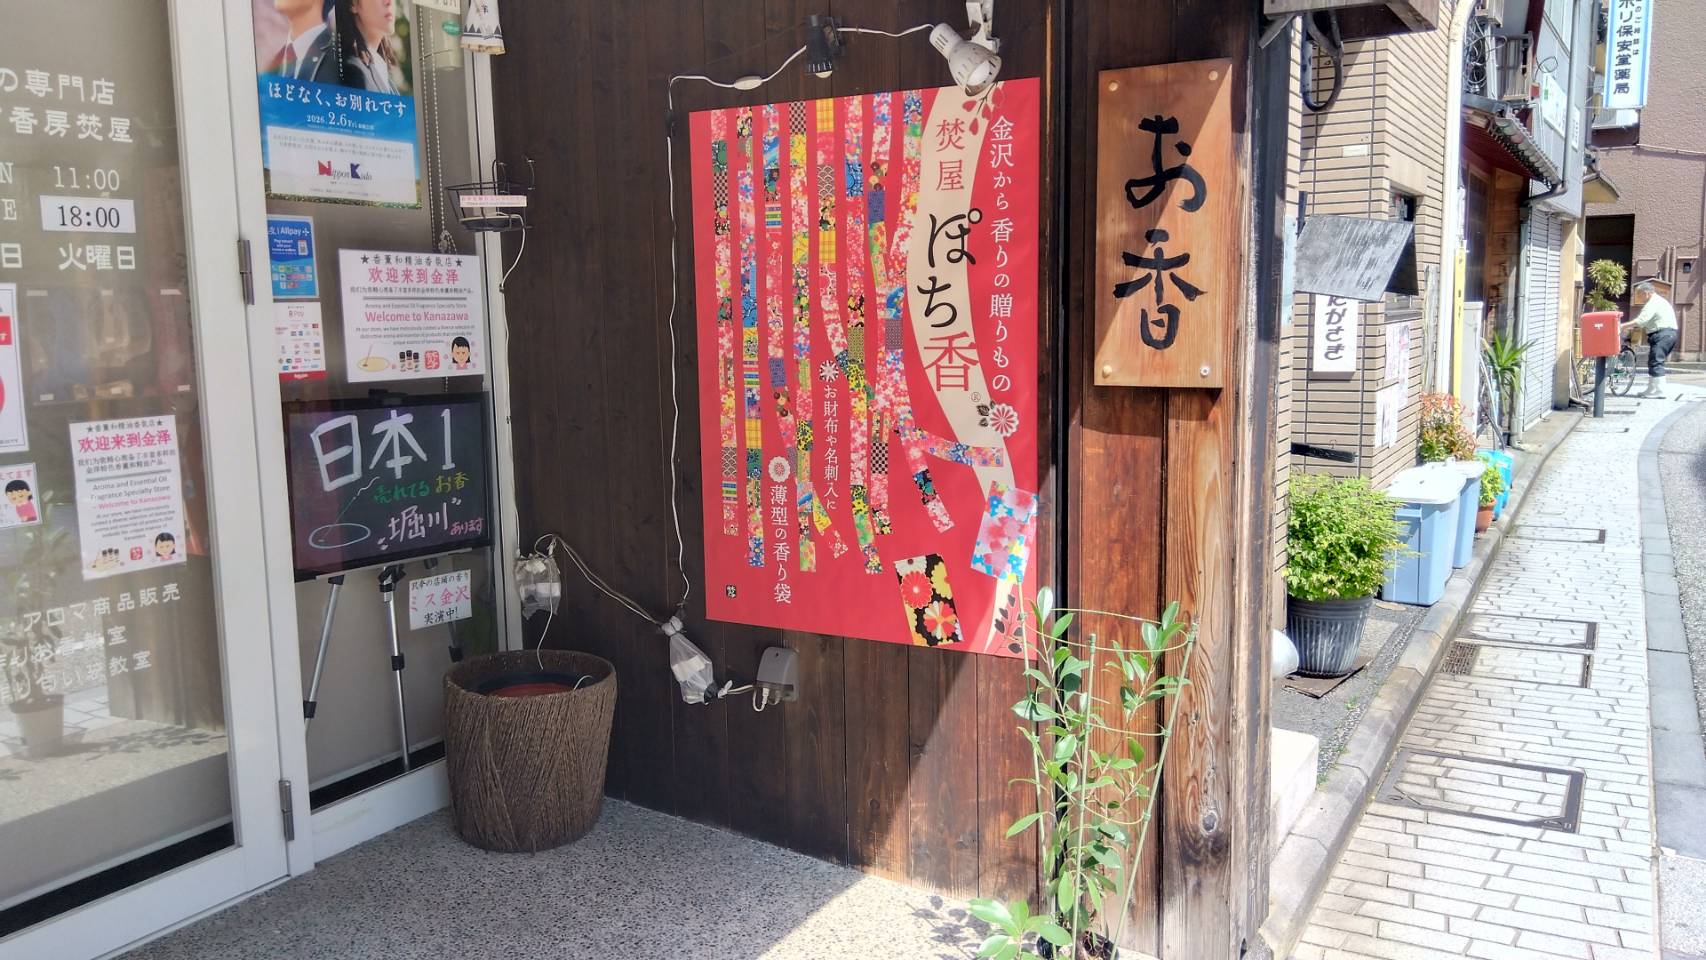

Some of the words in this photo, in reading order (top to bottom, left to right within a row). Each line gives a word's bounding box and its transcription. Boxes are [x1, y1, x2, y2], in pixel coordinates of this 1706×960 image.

[1632, 0, 1642, 56] のご相談は
[0, 67, 115, 105] の専門店
[268, 81, 407, 118] ほどなく、お別れです
[53, 166, 119, 191] 11:00
[936, 119, 965, 192] 焚屋
[58, 205, 120, 228] 18:00
[1112, 114, 1207, 350] お香
[58, 242, 135, 270] 火曜日
[368, 266, 458, 284] 欢迎来到金泽
[989, 114, 1015, 392] 金沢から香りの贈りもの
[365, 310, 410, 322] Welcome
[412, 312, 422, 322] to
[423, 311, 469, 321] Kanazawa
[917, 207, 982, 392] ぽち香
[78, 429, 171, 452] 欢迎来到金泽
[310, 408, 455, 492] 日本1
[823, 385, 840, 510] お財布や名刺入に
[770, 484, 792, 604] 薄型の香り袋
[23, 583, 181, 632] アロマ商品販売
